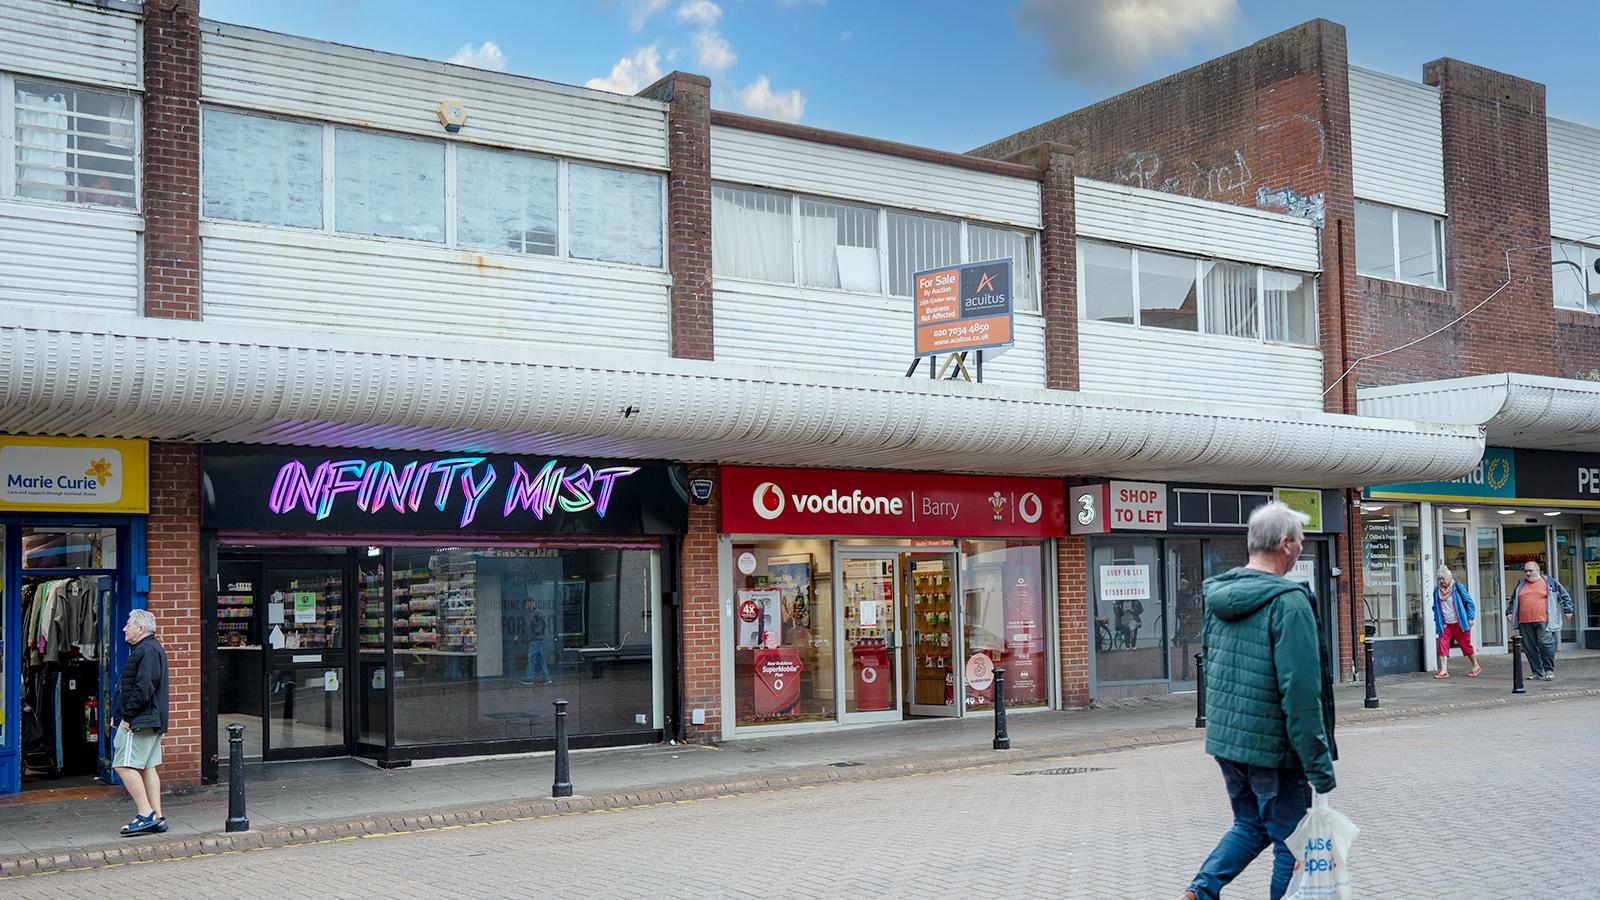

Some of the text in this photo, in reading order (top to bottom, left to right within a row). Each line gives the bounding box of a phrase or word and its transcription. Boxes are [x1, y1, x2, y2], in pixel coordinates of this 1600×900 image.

[920, 274, 956, 289] For Sale
[931, 286, 951, 295] Auction
[965, 293, 1005, 307] acuitus
[933, 323, 990, 337] 020 7034 4850
[934, 333, 990, 346] www.acuitus.co.uk
[7, 474, 97, 490] Marie Curie
[1578, 467, 1600, 494] PE
[268, 456, 642, 528] INFINITY MIST
[1119, 489, 1158, 504] SHOP
[791, 488, 960, 521] vodafone Barry
[1077, 493, 1095, 526] 3
[1115, 508, 1163, 524] TO LET
[742, 604, 756, 614] 4x
[1305, 838, 1332, 851] use
